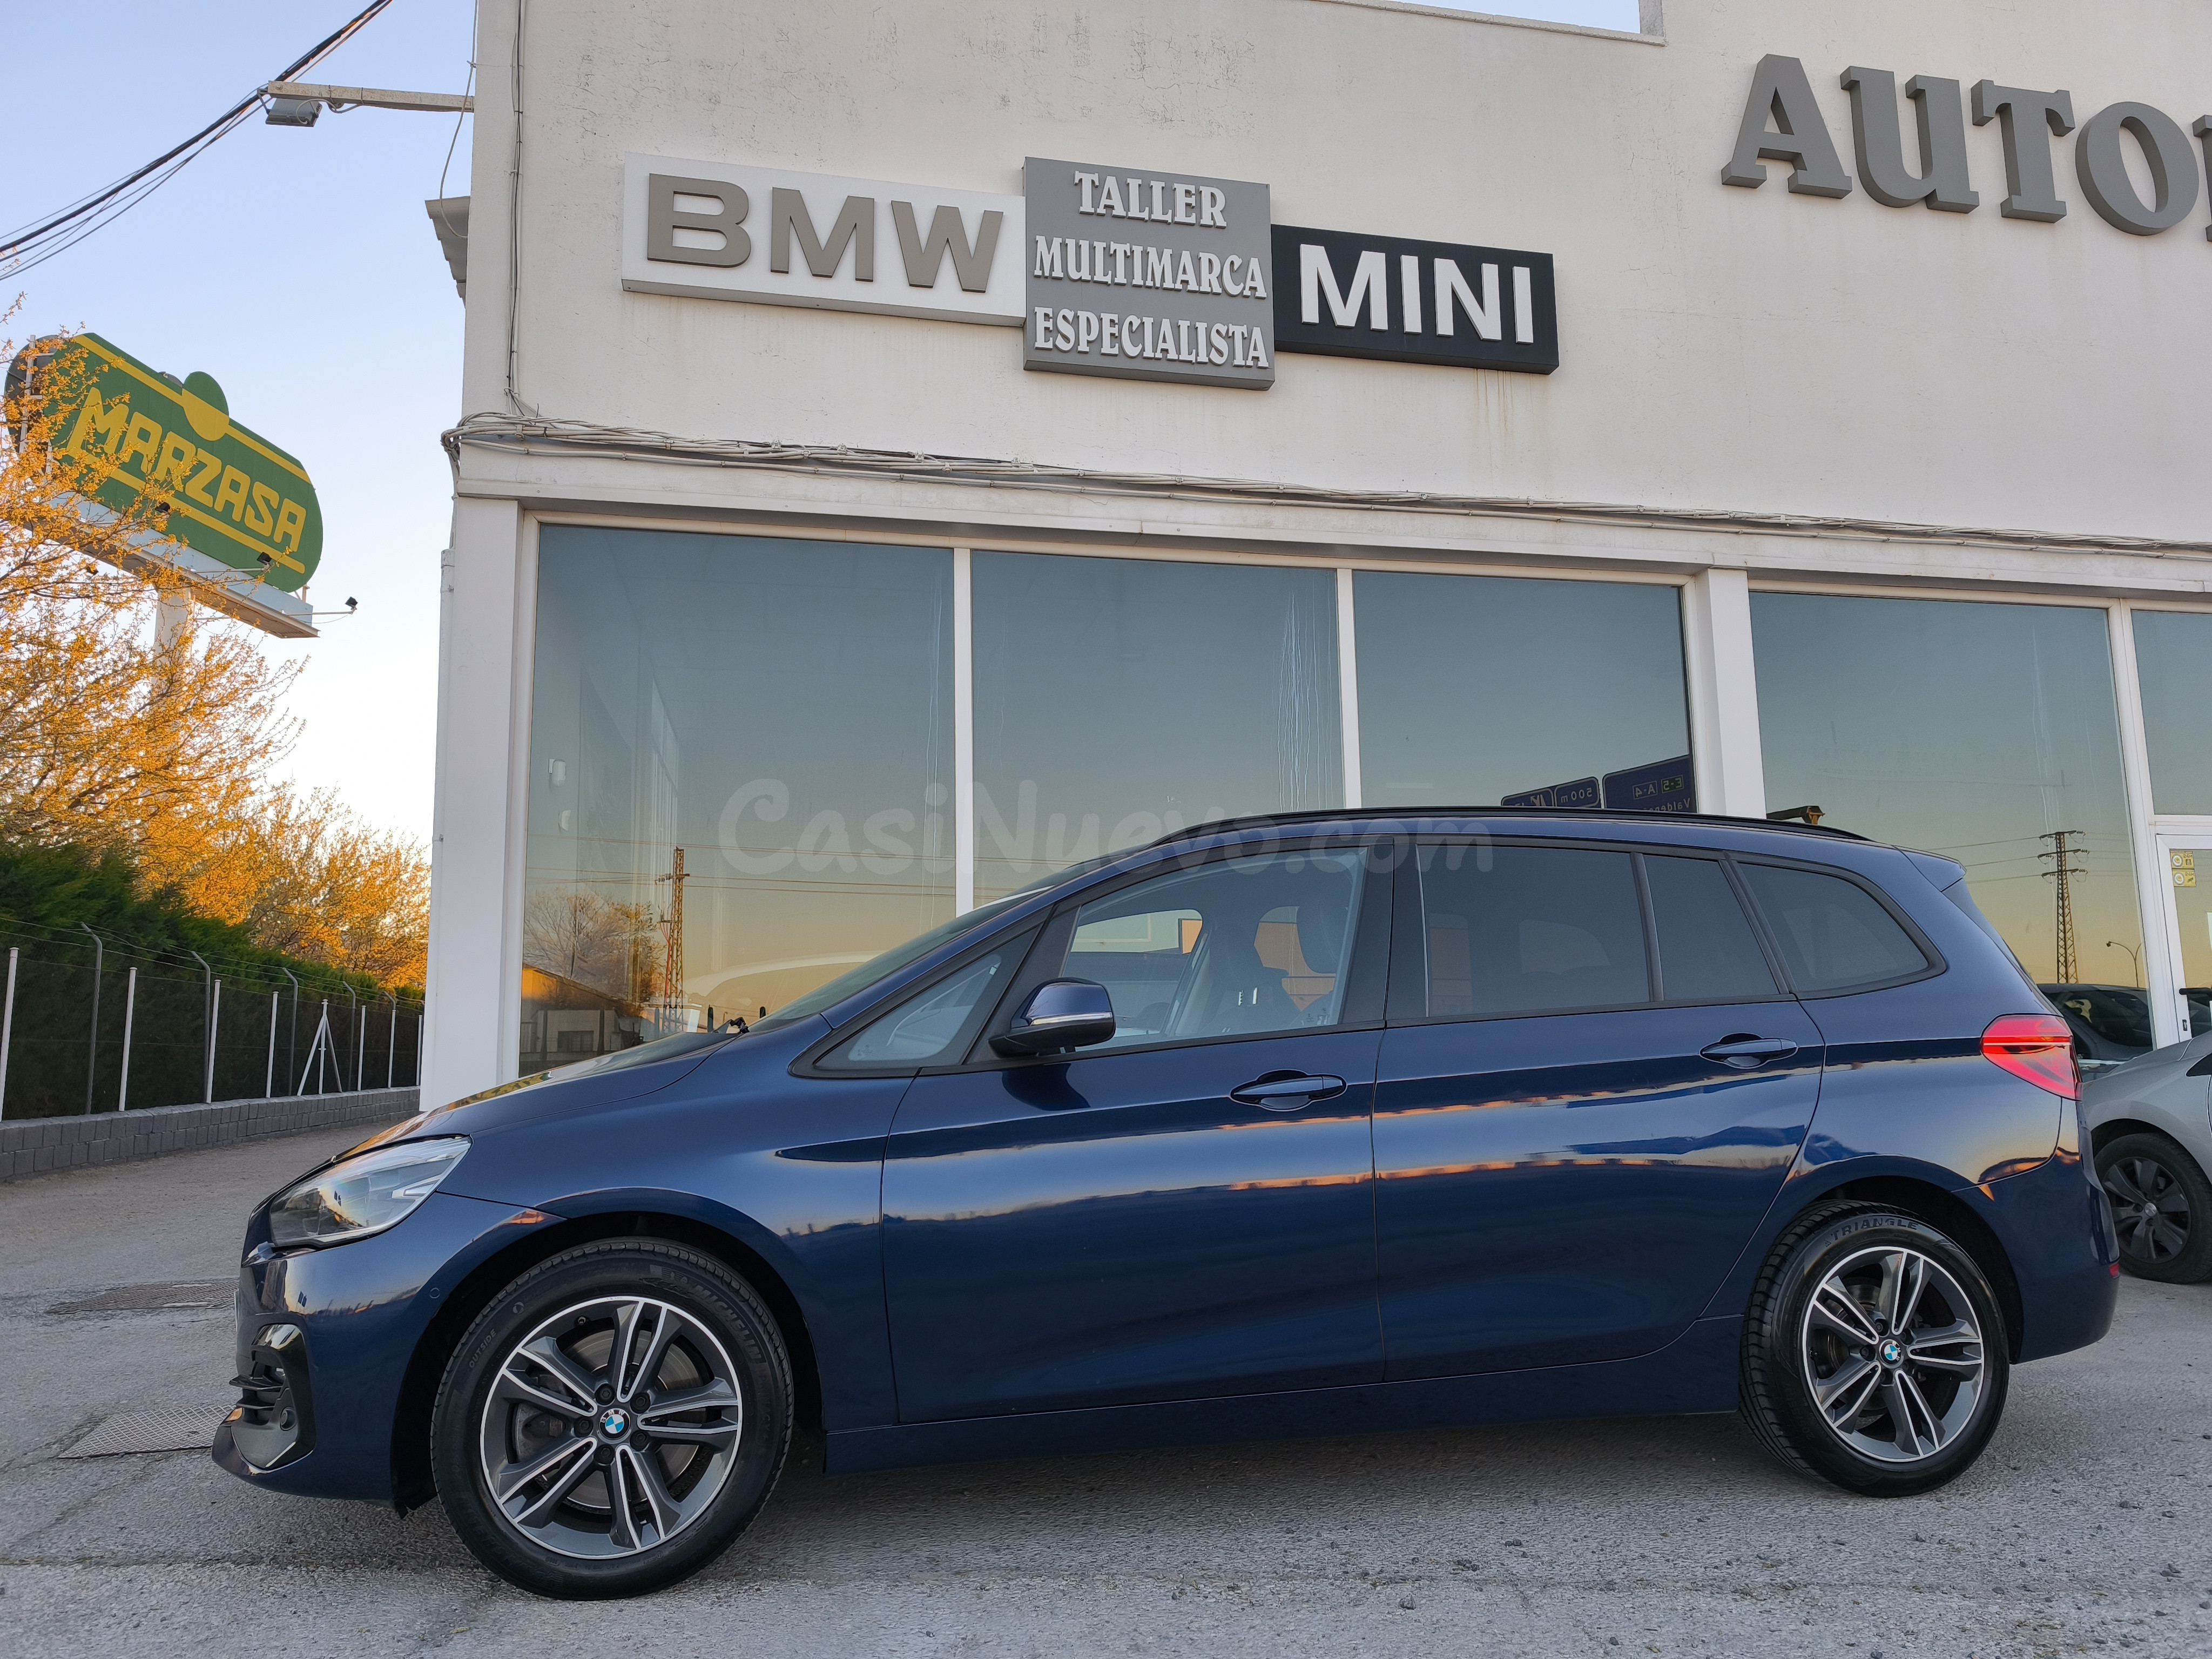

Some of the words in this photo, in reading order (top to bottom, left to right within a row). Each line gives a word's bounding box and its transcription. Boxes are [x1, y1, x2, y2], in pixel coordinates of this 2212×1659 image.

[1721, 53, 2212, 242] AUTO
[647, 172, 1004, 293] BMW
[1073, 170, 1228, 229] TALLER
[1034, 234, 1268, 300] MULTIMARCA
[1299, 243, 1535, 346] MINI
[1034, 306, 1270, 369] ESPECIALISTA
[66, 387, 307, 552] MARZASA
[1831, 1218, 1919, 1241] TRIANGLE
[469, 1328, 496, 1368] OUTSIDE
[693, 1284, 763, 1360] MICHELIN
[600, 1409, 626, 1424] BMW
